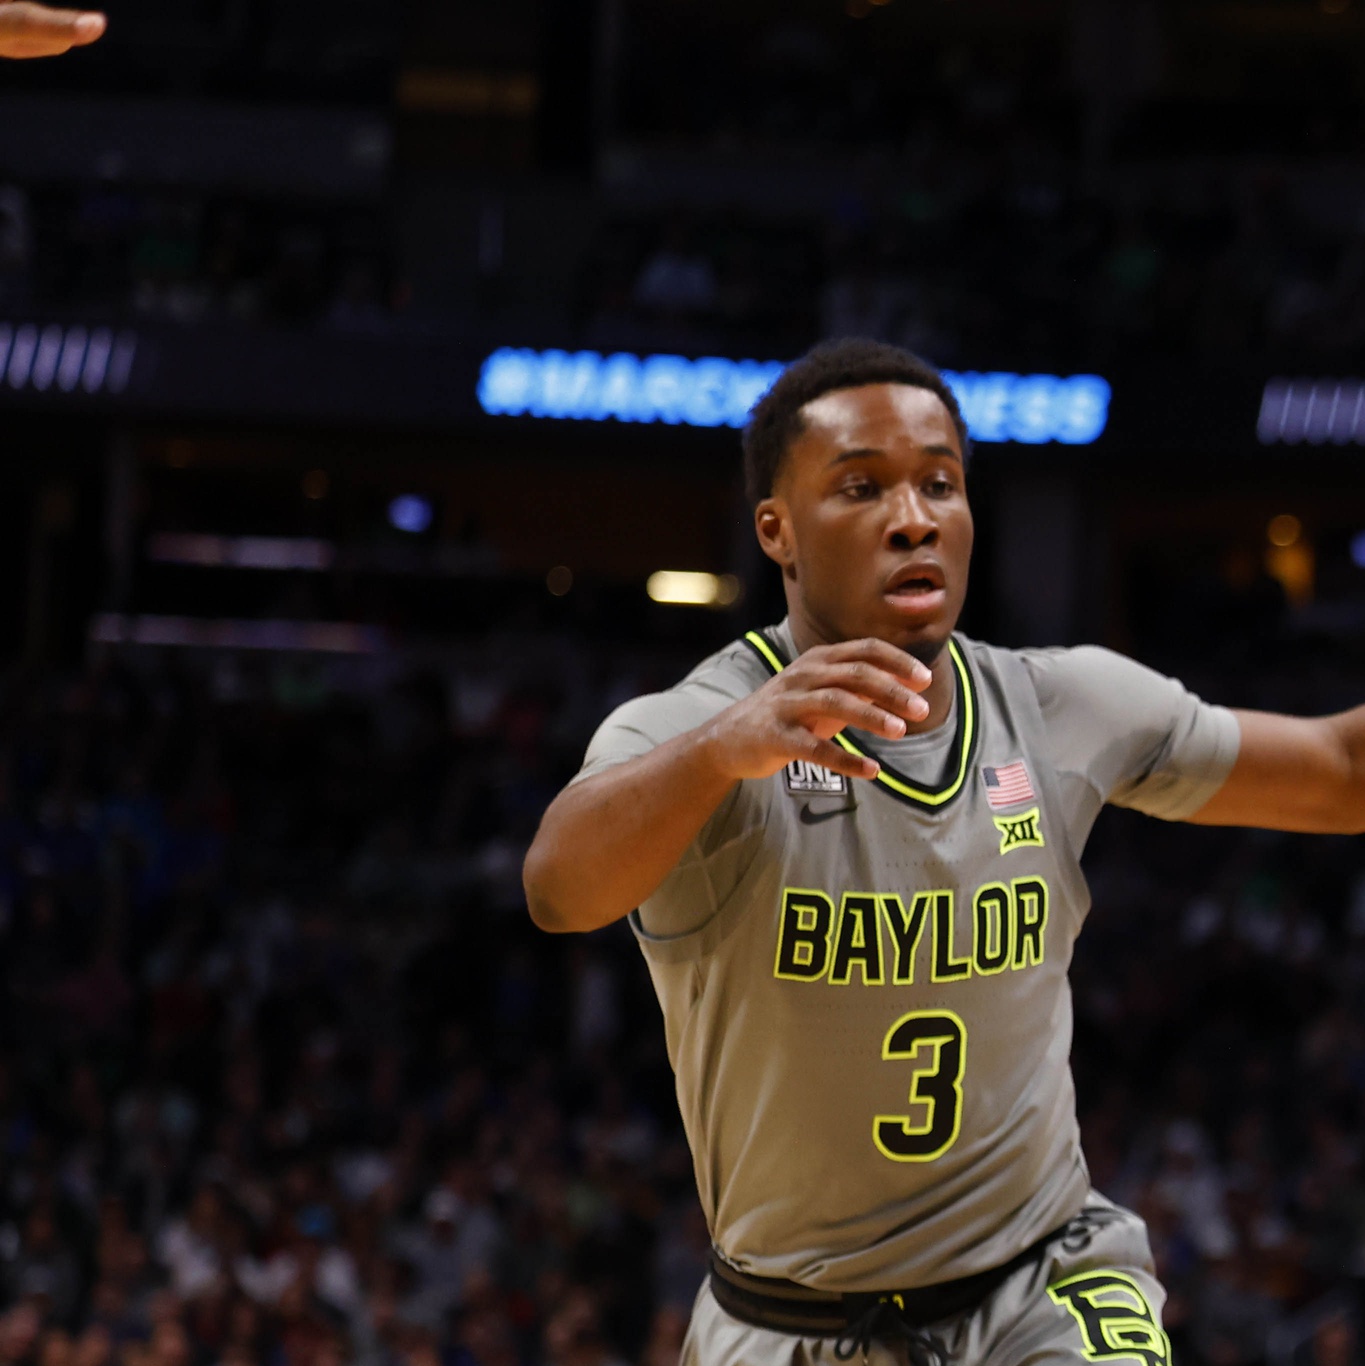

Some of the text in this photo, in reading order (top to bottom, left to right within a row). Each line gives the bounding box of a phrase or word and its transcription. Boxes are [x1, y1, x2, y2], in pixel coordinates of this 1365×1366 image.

[998, 814, 1040, 848] XII
[773, 874, 1049, 987] BAYLOR
[871, 1008, 968, 1164] 3
